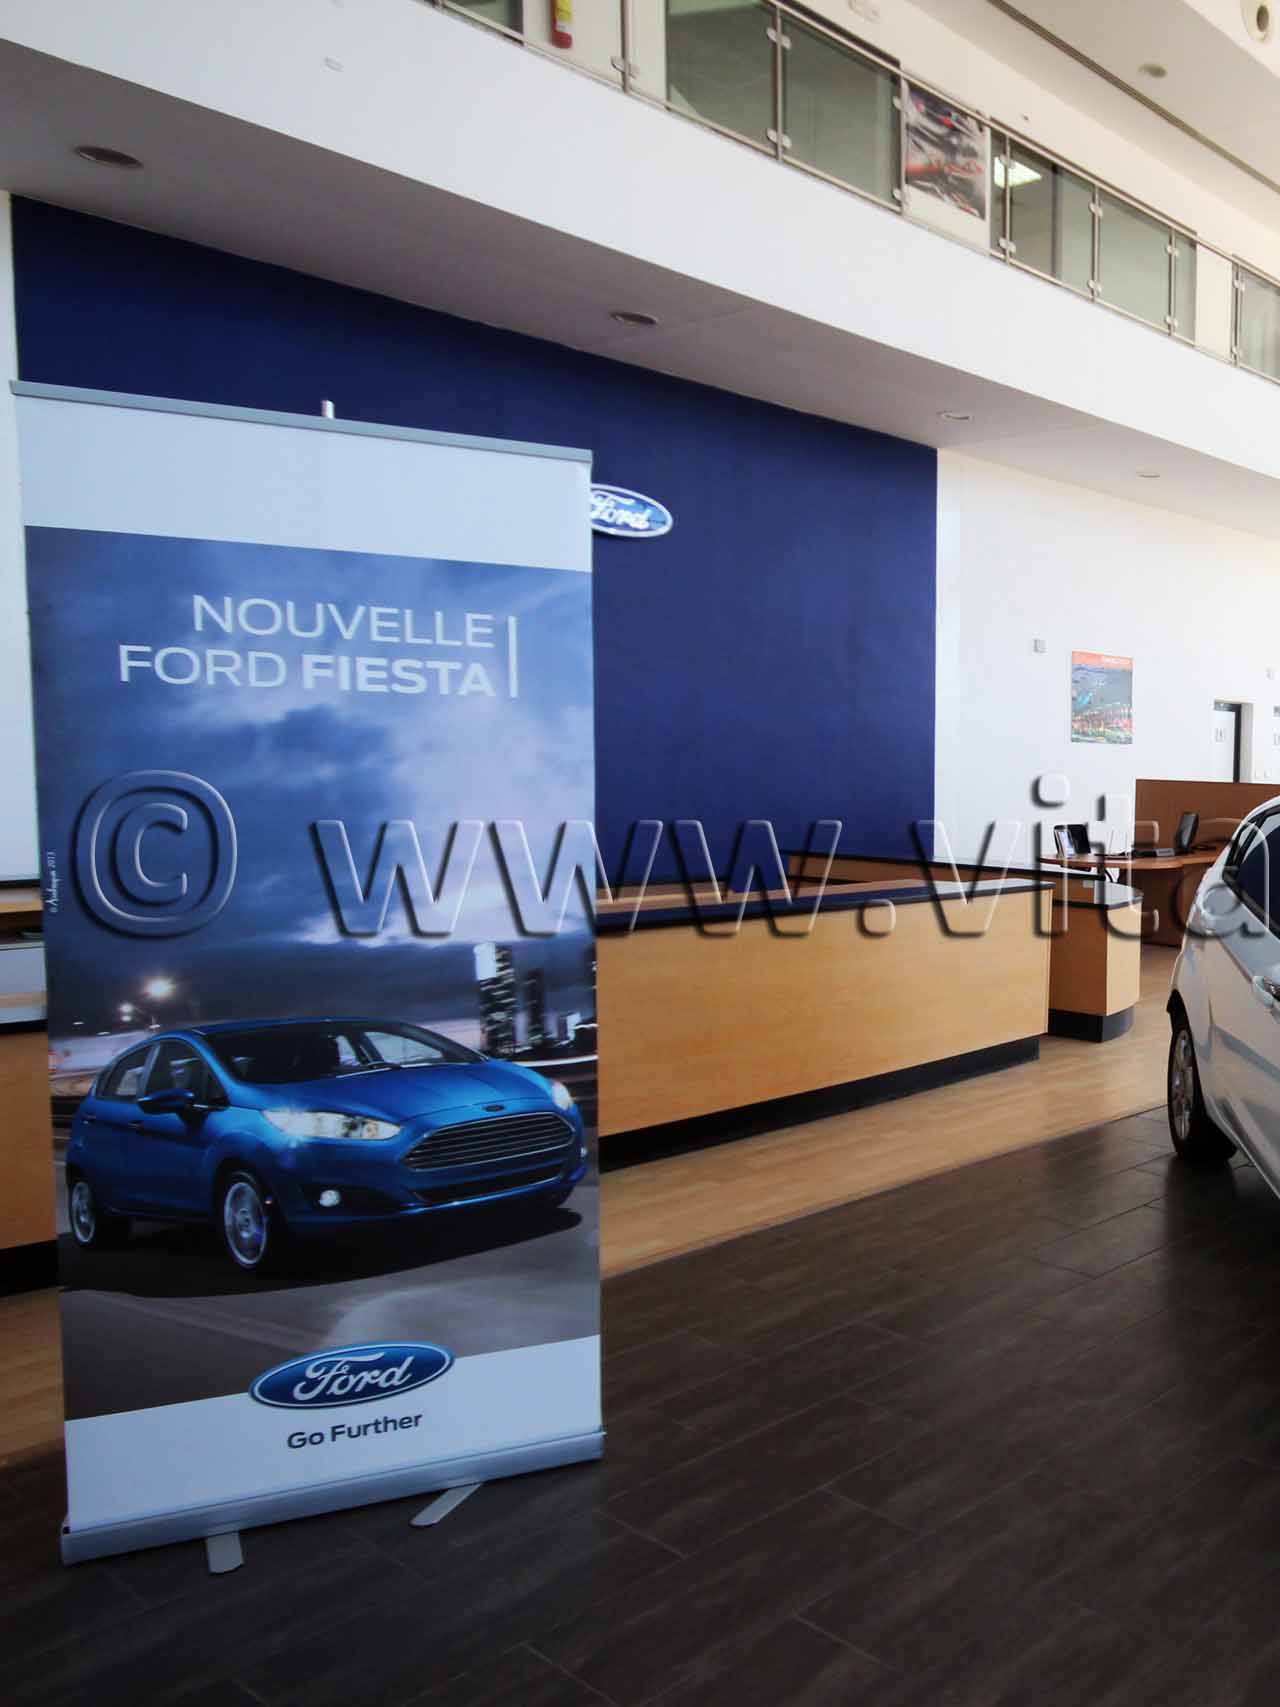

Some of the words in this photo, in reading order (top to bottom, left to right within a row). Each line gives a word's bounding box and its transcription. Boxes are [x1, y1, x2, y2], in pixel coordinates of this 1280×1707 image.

[193, 594, 495, 648] NOUVELLE
[119, 644, 287, 688] FORD
[303, 654, 496, 697] FIESTA
[293, 1351, 415, 1401] Ford
[287, 1431, 324, 1449] Go
[331, 1413, 424, 1442] Further
